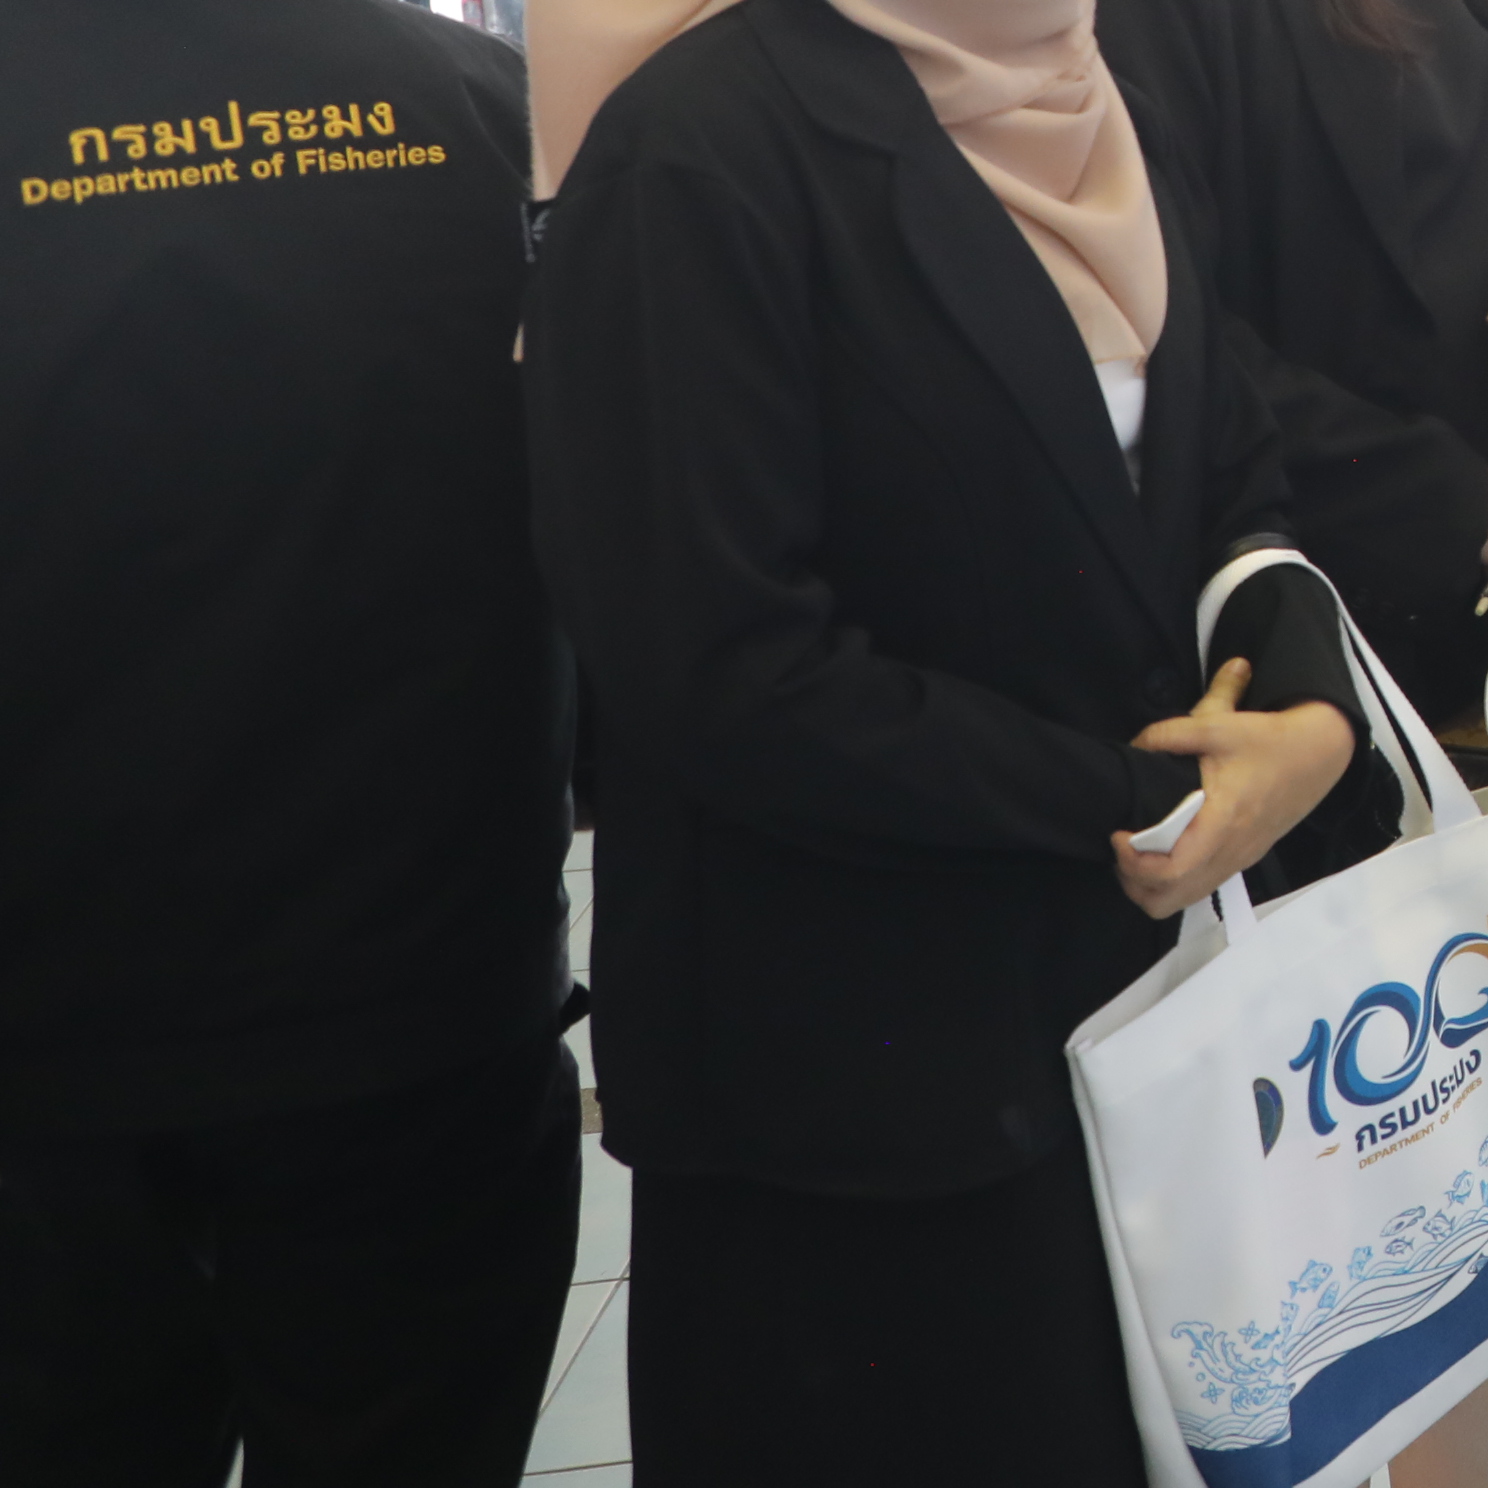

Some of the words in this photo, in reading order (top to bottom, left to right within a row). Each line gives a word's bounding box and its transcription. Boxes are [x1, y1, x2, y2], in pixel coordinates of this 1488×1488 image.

[69, 100, 396, 164] กรมประมง
[21, 156, 239, 205] Department
[250, 152, 285, 181] of
[296, 142, 446, 175] Fisheries
[1355, 1049, 1482, 1153] กรมประมง
[1359, 1123, 1435, 1170] DEPARTMENT
[1439, 1111, 1450, 1125] OF
[1453, 1077, 1483, 1114] FISHERIES
